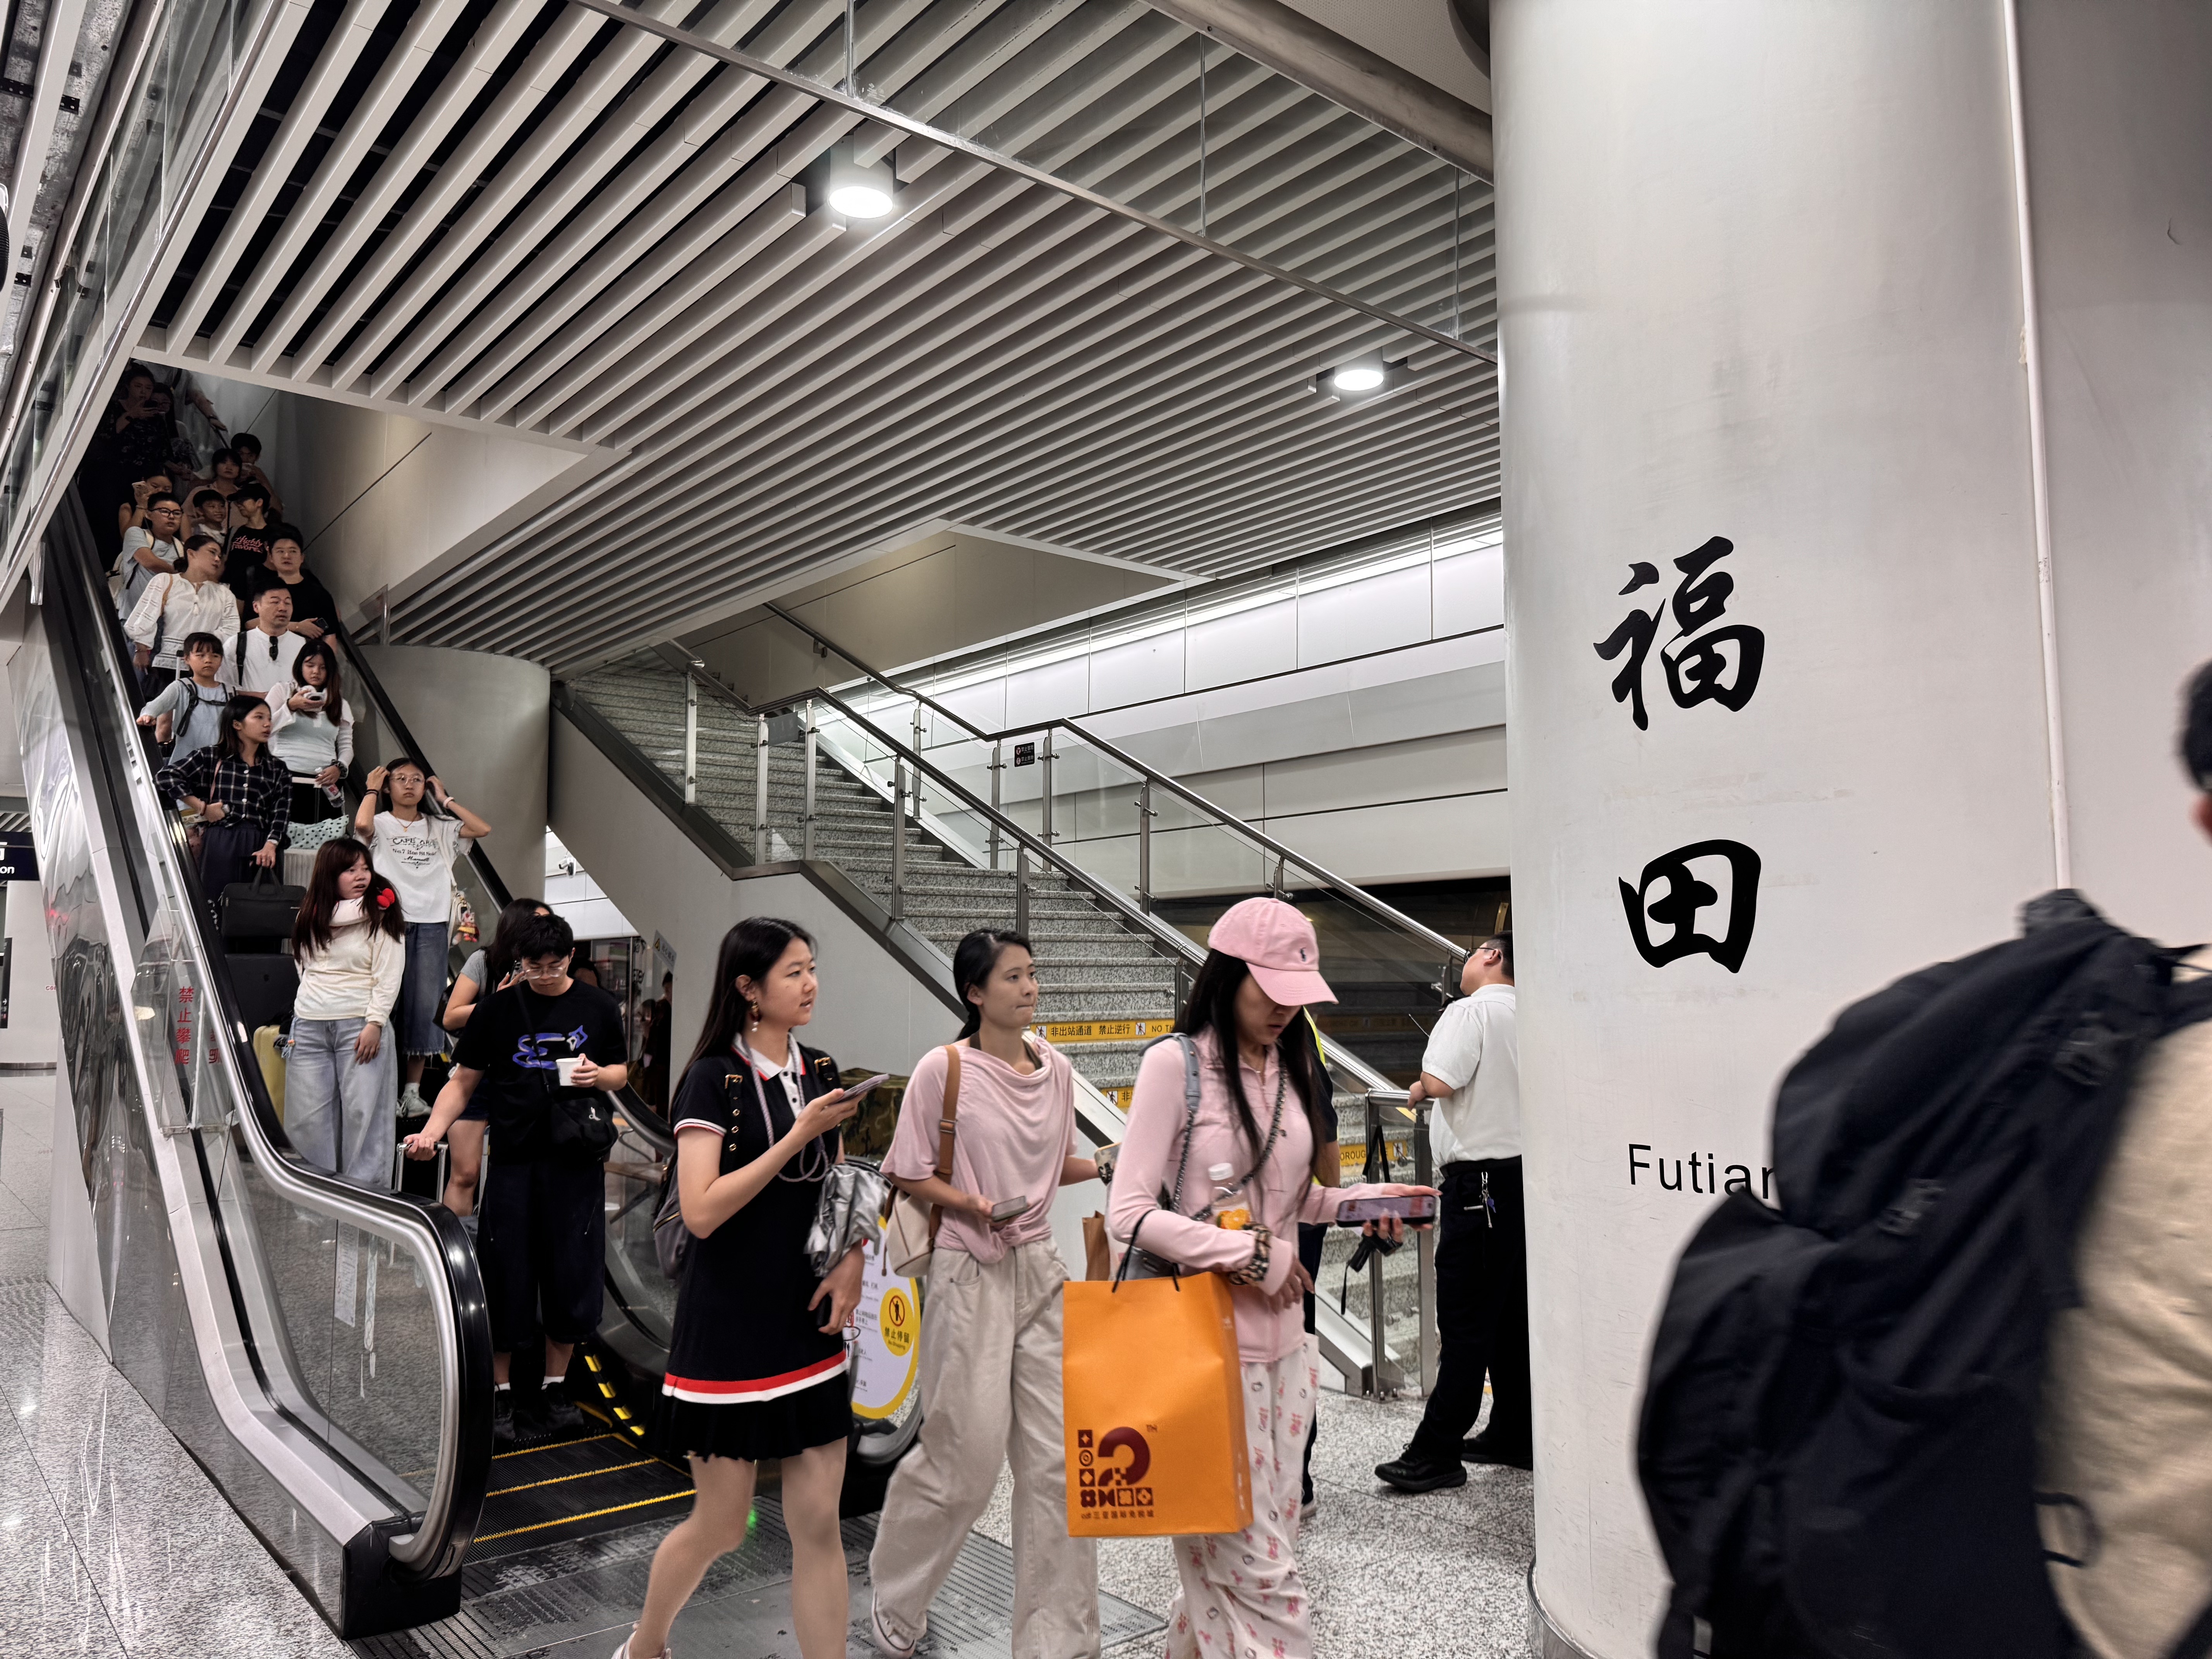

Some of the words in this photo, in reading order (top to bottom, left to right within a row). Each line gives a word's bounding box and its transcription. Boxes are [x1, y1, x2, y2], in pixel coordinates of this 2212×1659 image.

[1593, 536, 1765, 973] 福田
[175, 986, 194, 1065] 禁止攀爬
[1050, 1025, 1092, 1037] 非出站通道
[1099, 1024, 1130, 1035] 禁止逆行
